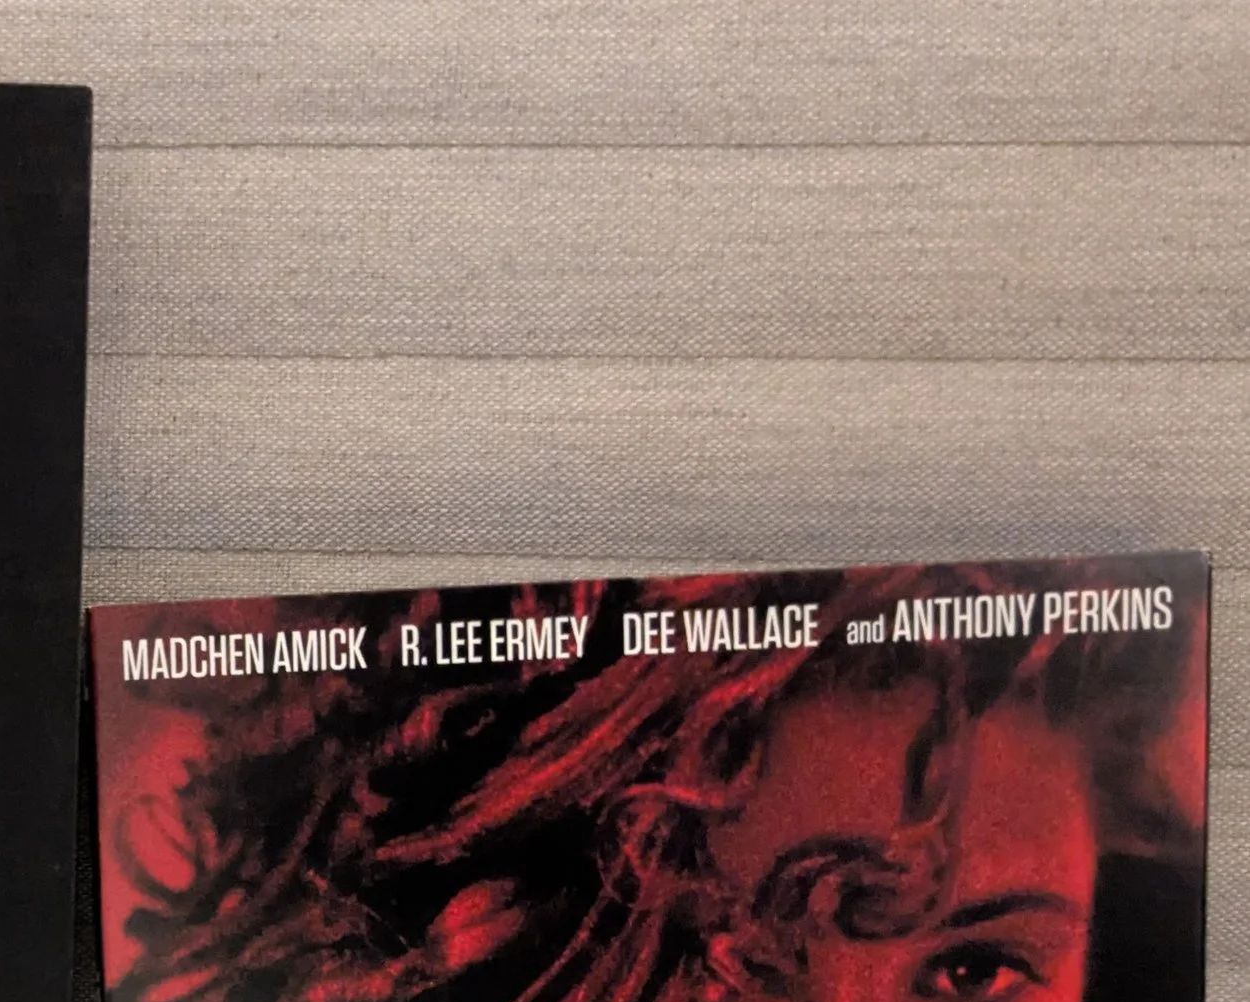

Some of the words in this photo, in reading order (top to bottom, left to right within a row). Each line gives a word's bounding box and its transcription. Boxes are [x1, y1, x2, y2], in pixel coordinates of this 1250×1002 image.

[122, 632, 265, 681] MADCHEN
[272, 626, 368, 674] AMICK
[401, 624, 428, 667] R.
[435, 620, 483, 665] LEE
[489, 615, 589, 662] ERMEY
[623, 610, 677, 656] DEE
[683, 603, 820, 653] WALLACE
[846, 614, 886, 645] and
[892, 593, 1037, 643] ANTHONY
[1044, 585, 1174, 635] PERKINS
